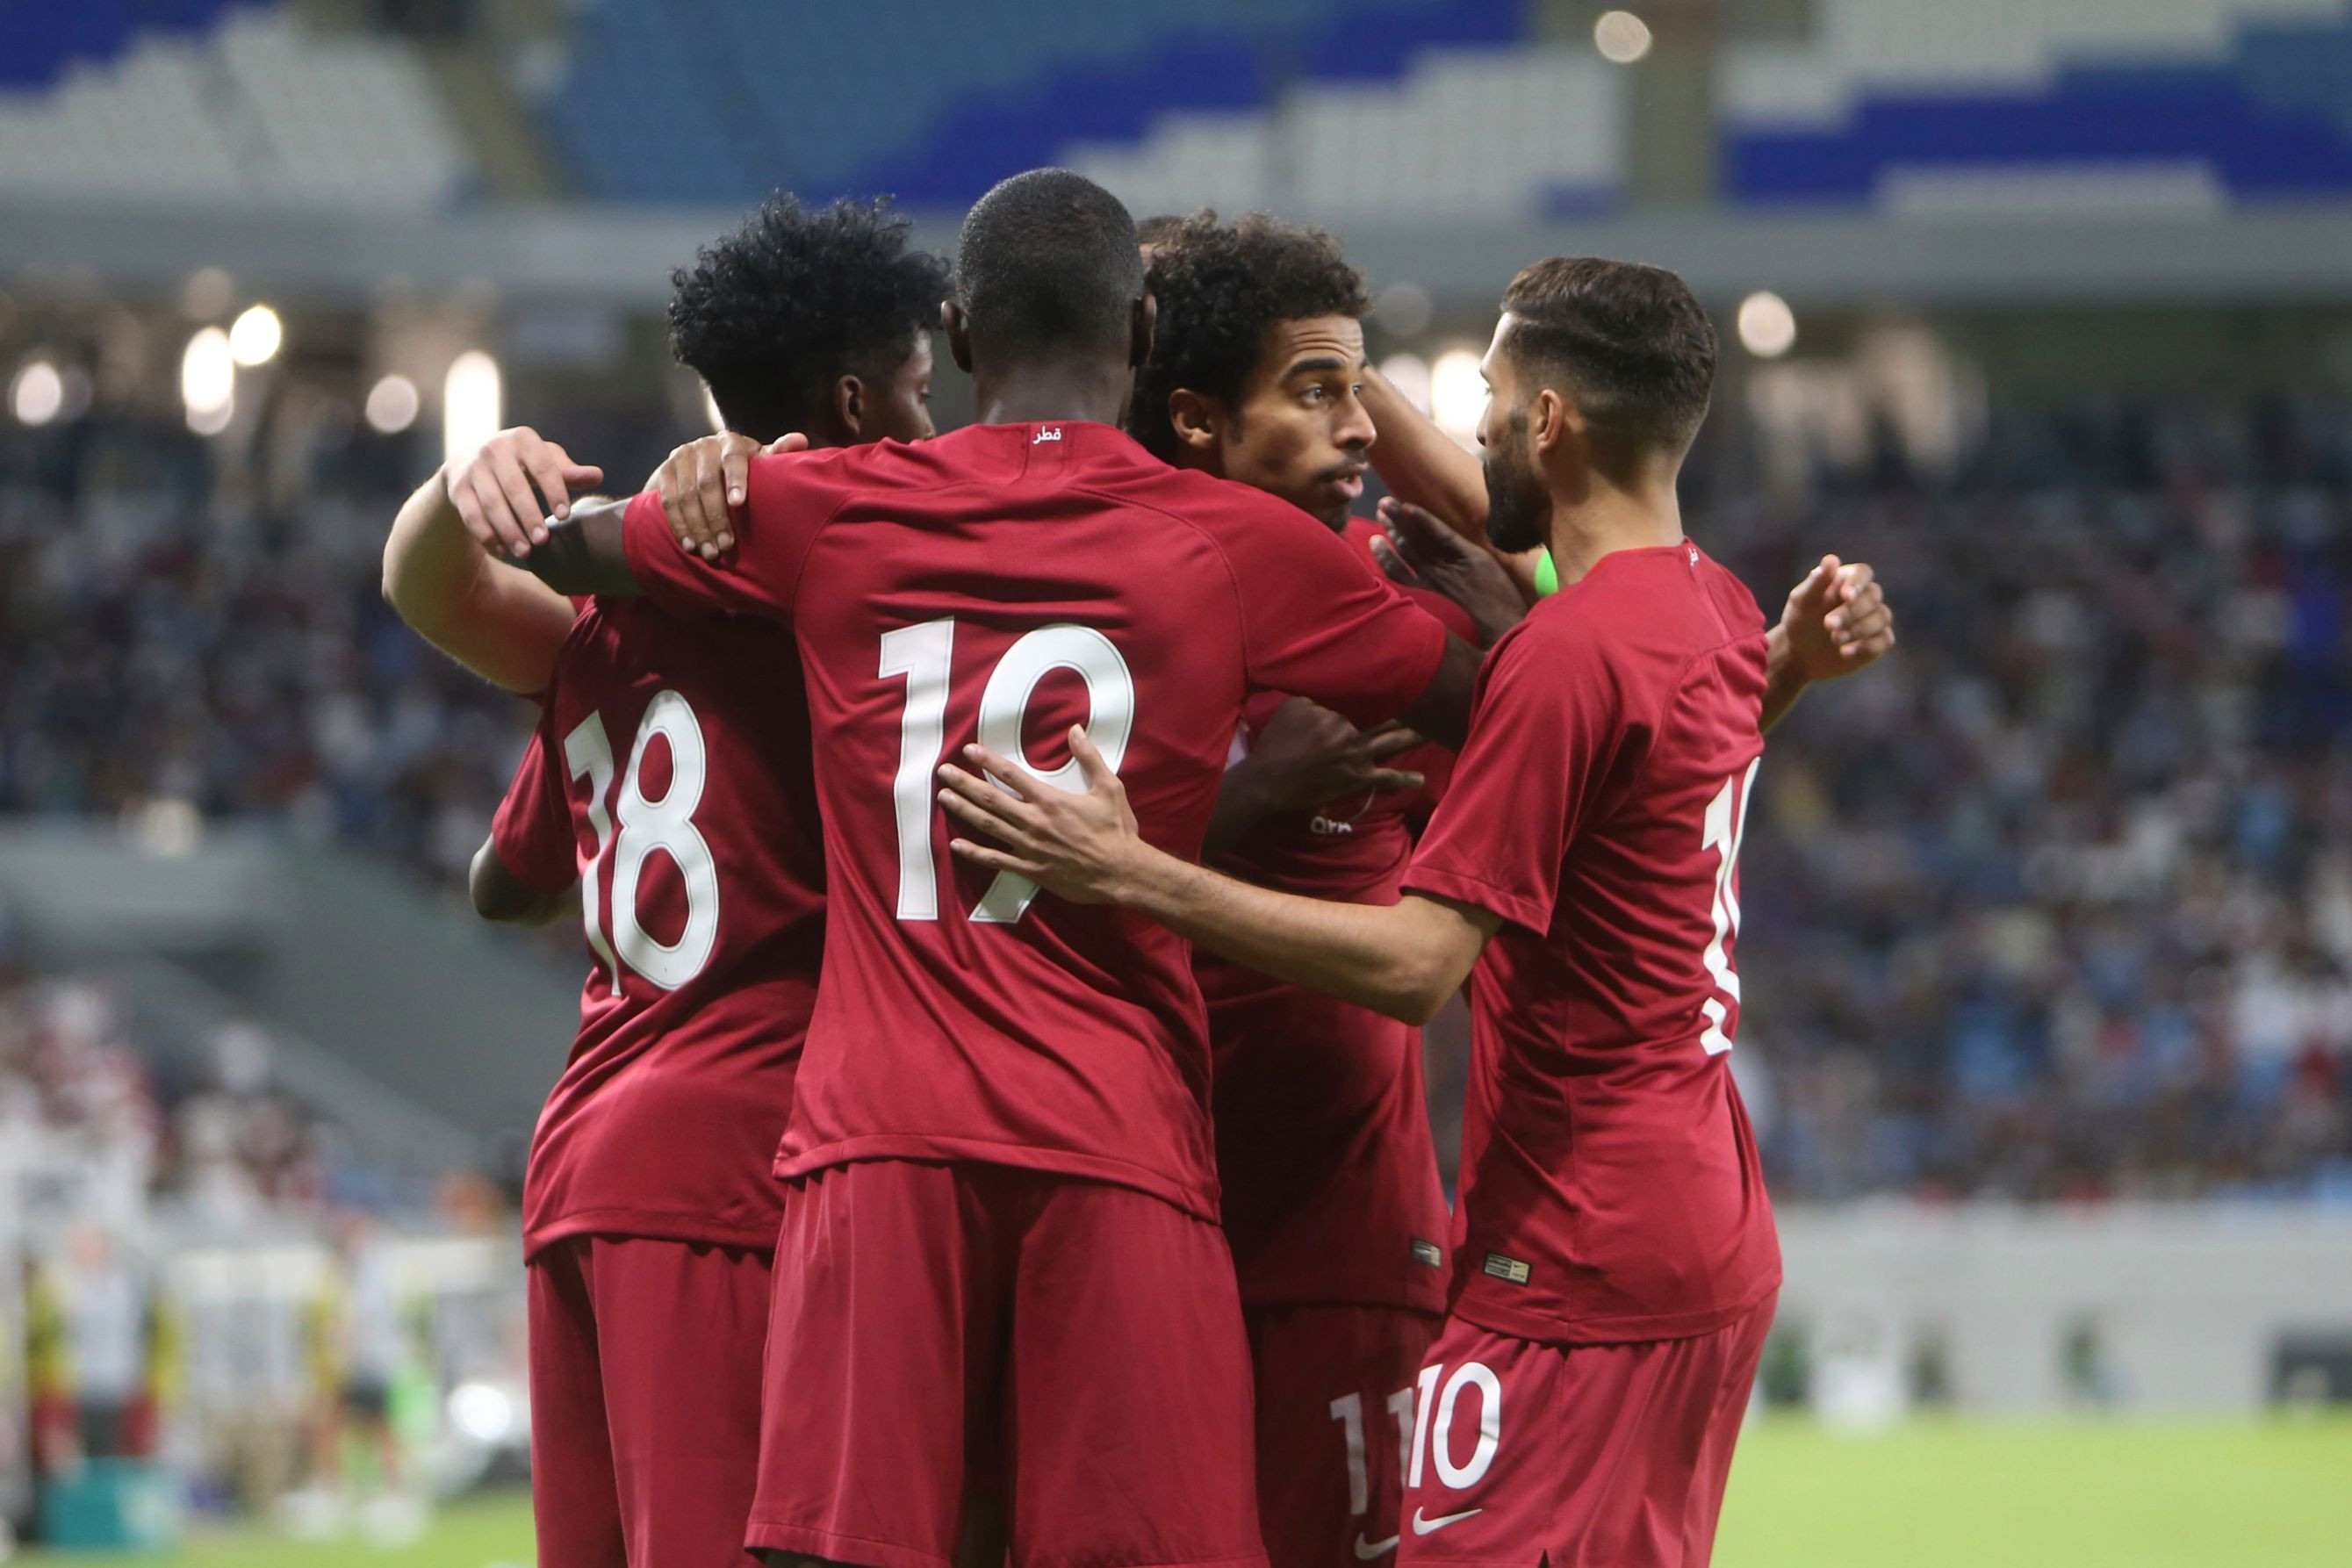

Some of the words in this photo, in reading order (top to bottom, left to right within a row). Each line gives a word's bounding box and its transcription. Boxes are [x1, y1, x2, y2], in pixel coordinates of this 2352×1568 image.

[1032, 425, 1062, 444] قطر
[878, 615, 1135, 924] 19
[564, 689, 719, 996] 18
[1329, 1386, 1414, 1515] 11
[1408, 1361, 1501, 1490] 10
